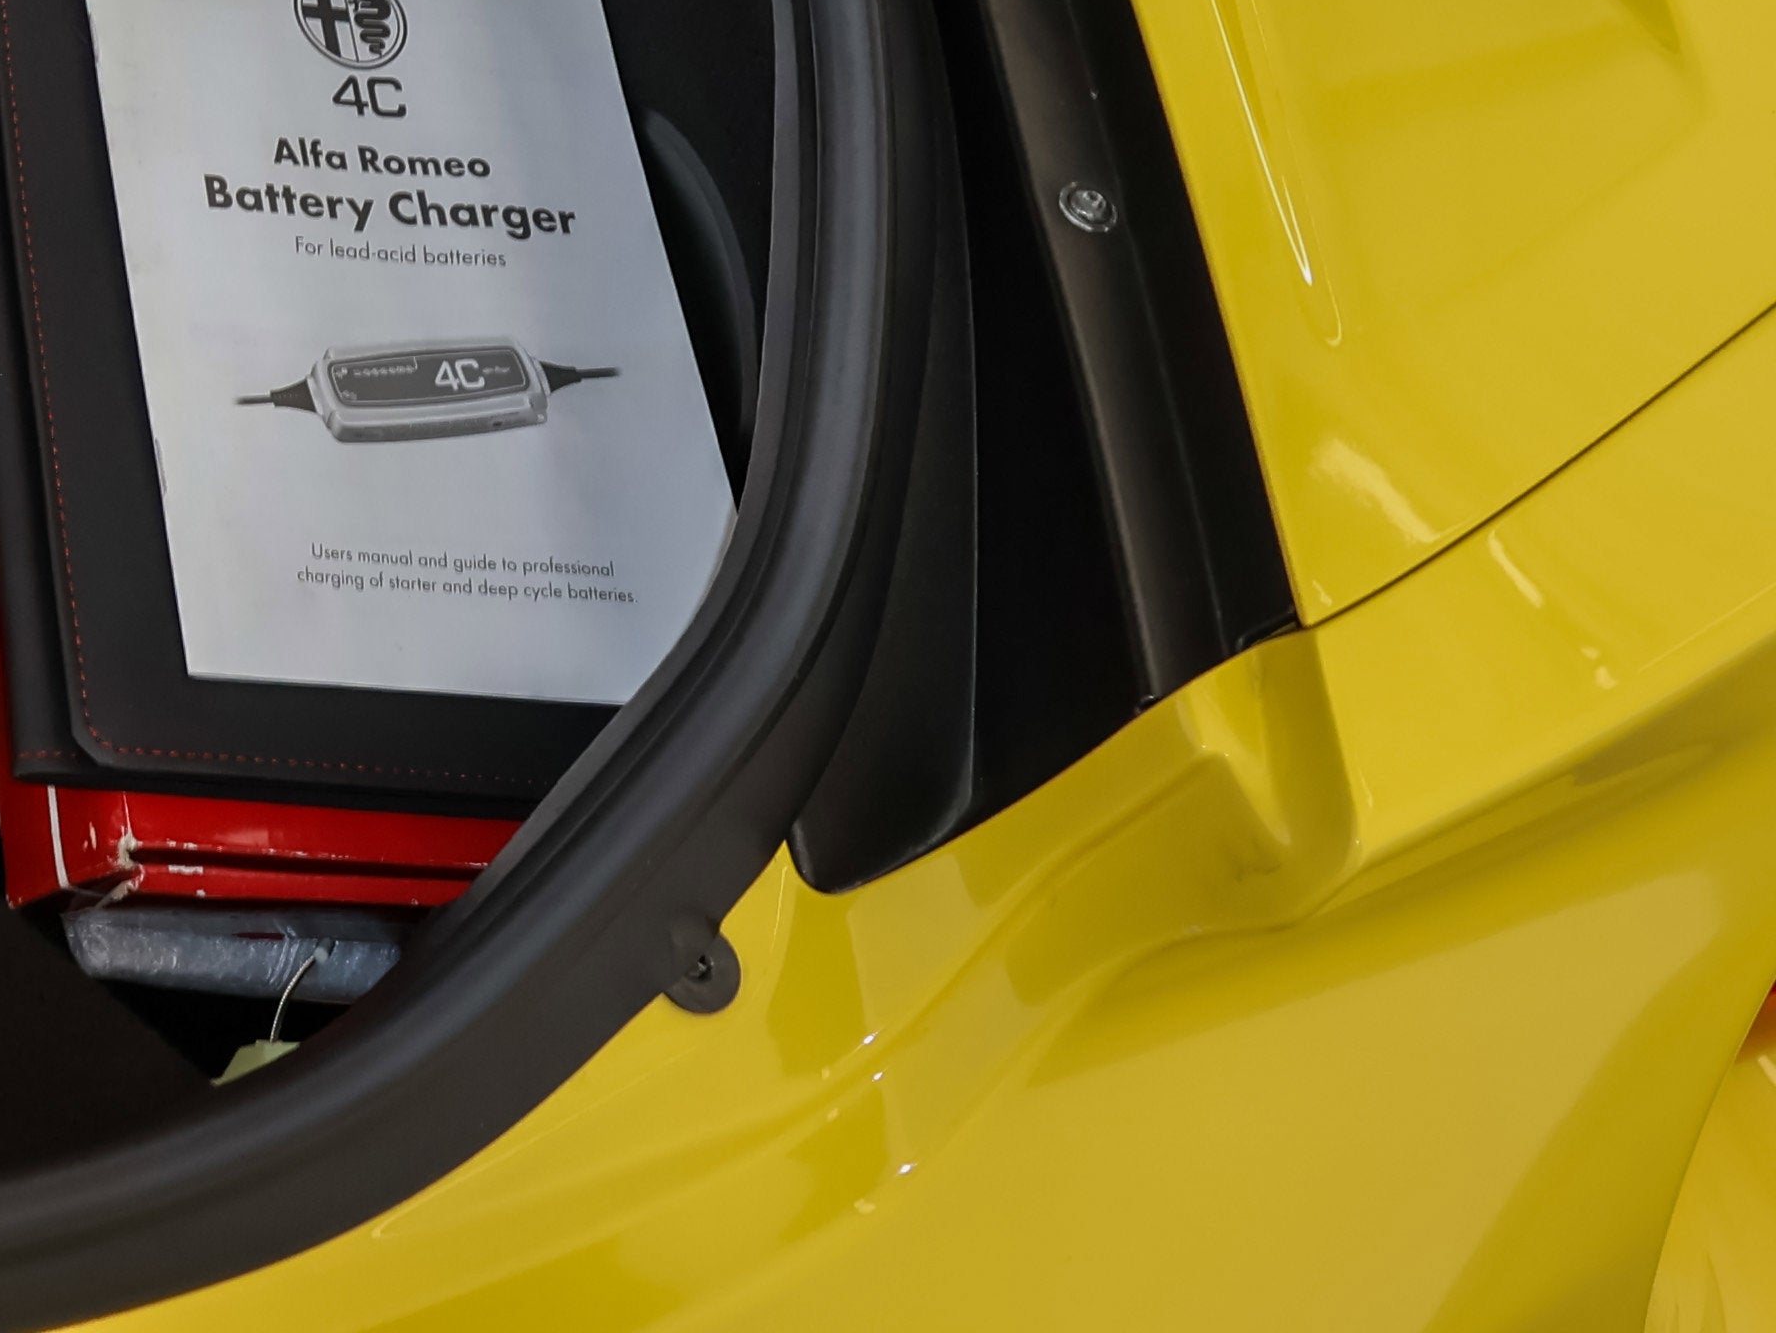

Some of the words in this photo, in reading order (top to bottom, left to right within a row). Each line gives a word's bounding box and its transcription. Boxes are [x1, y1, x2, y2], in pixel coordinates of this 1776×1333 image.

[331, 74, 408, 119] 4C
[273, 136, 349, 172] Alfa
[357, 144, 492, 178] Romeo
[203, 173, 375, 233] Battery
[387, 188, 577, 241] Charger
[295, 235, 324, 255] For
[329, 237, 417, 264] lead-acid
[423, 244, 507, 267] batteries
[434, 357, 487, 392] 4C
[311, 541, 353, 561] Users
[357, 549, 414, 566] manual
[418, 550, 449, 569] and
[453, 553, 497, 574] guide
[501, 556, 518, 572] to
[522, 555, 615, 577] professional
[296, 565, 365, 591] charging
[368, 570, 384, 588] of
[388, 576, 438, 593] starter
[442, 577, 473, 595] and
[477, 578, 519, 600] deep
[523, 581, 563, 602] cycle
[567, 582, 639, 604] batteries.
